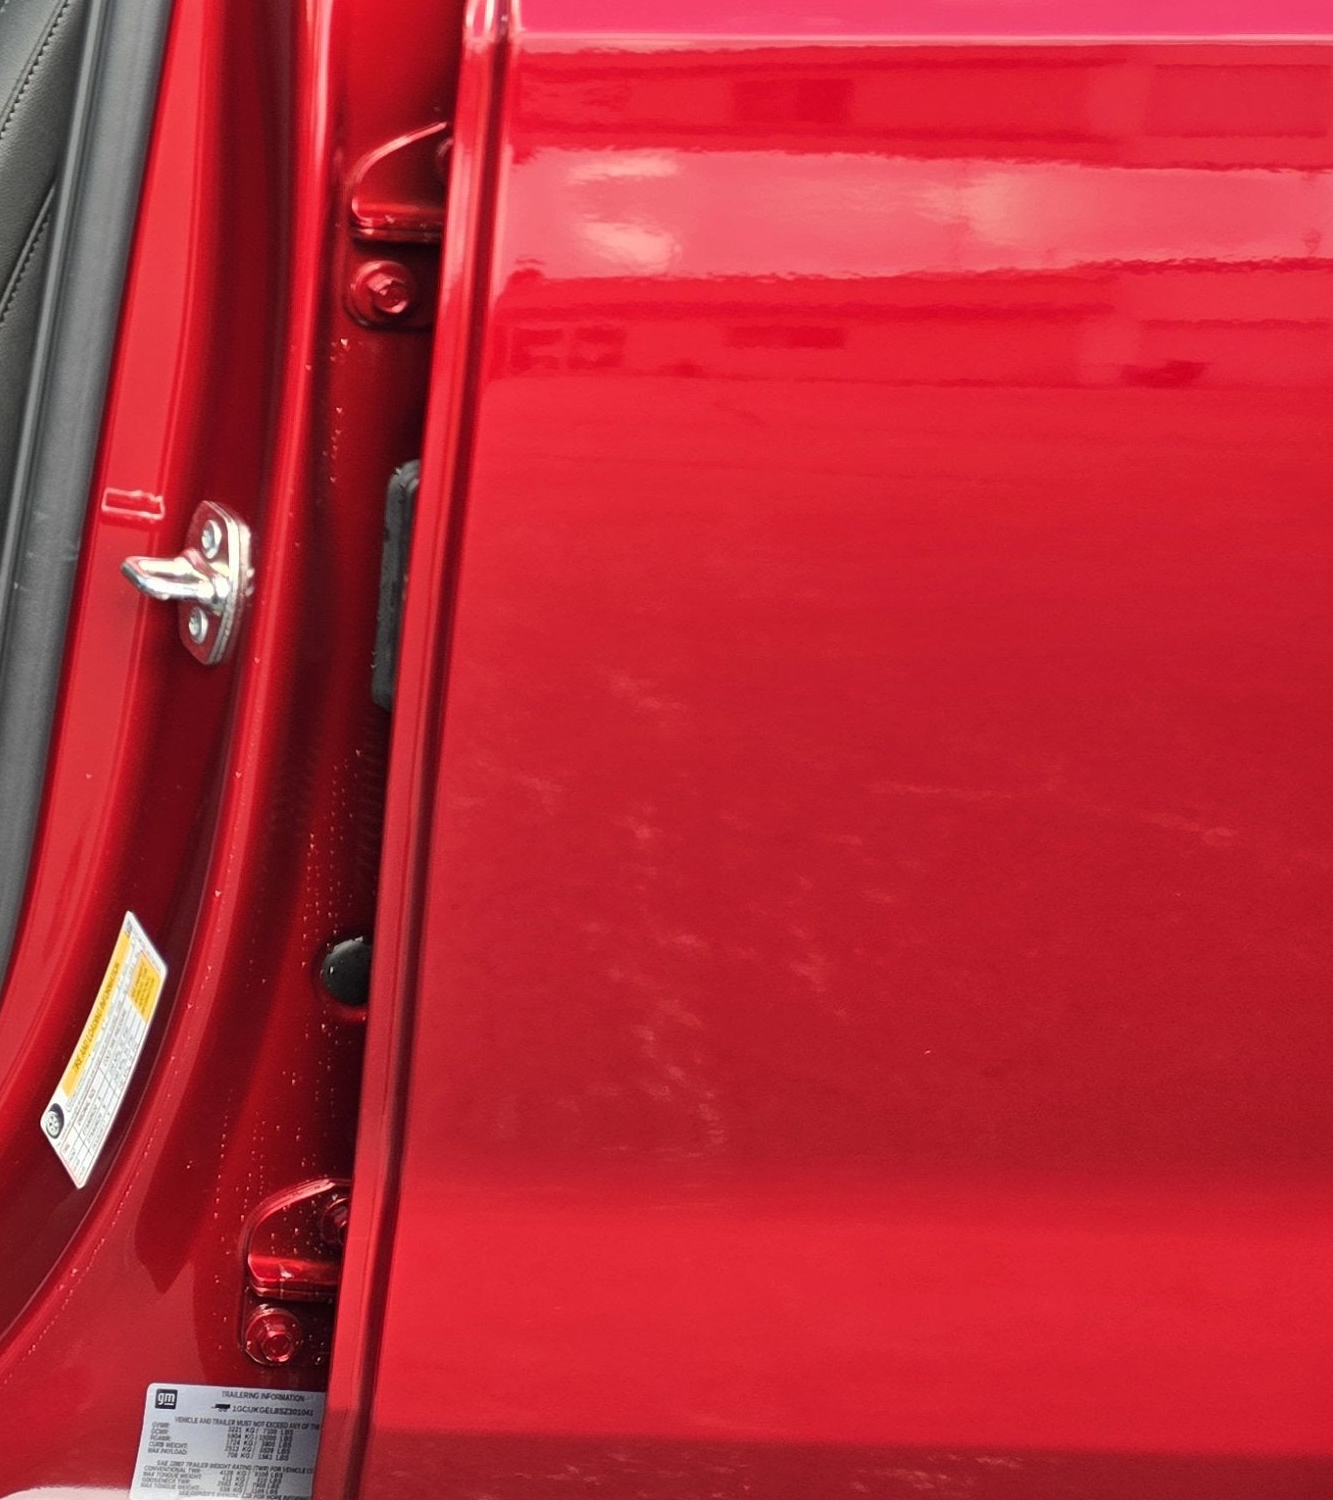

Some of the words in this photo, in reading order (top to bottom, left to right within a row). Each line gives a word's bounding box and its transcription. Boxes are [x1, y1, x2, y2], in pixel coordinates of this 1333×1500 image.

[156, 1393, 176, 1405] gm
[221, 1390, 259, 1399] TRAILERING
[260, 1392, 304, 1401] INFORMATION
